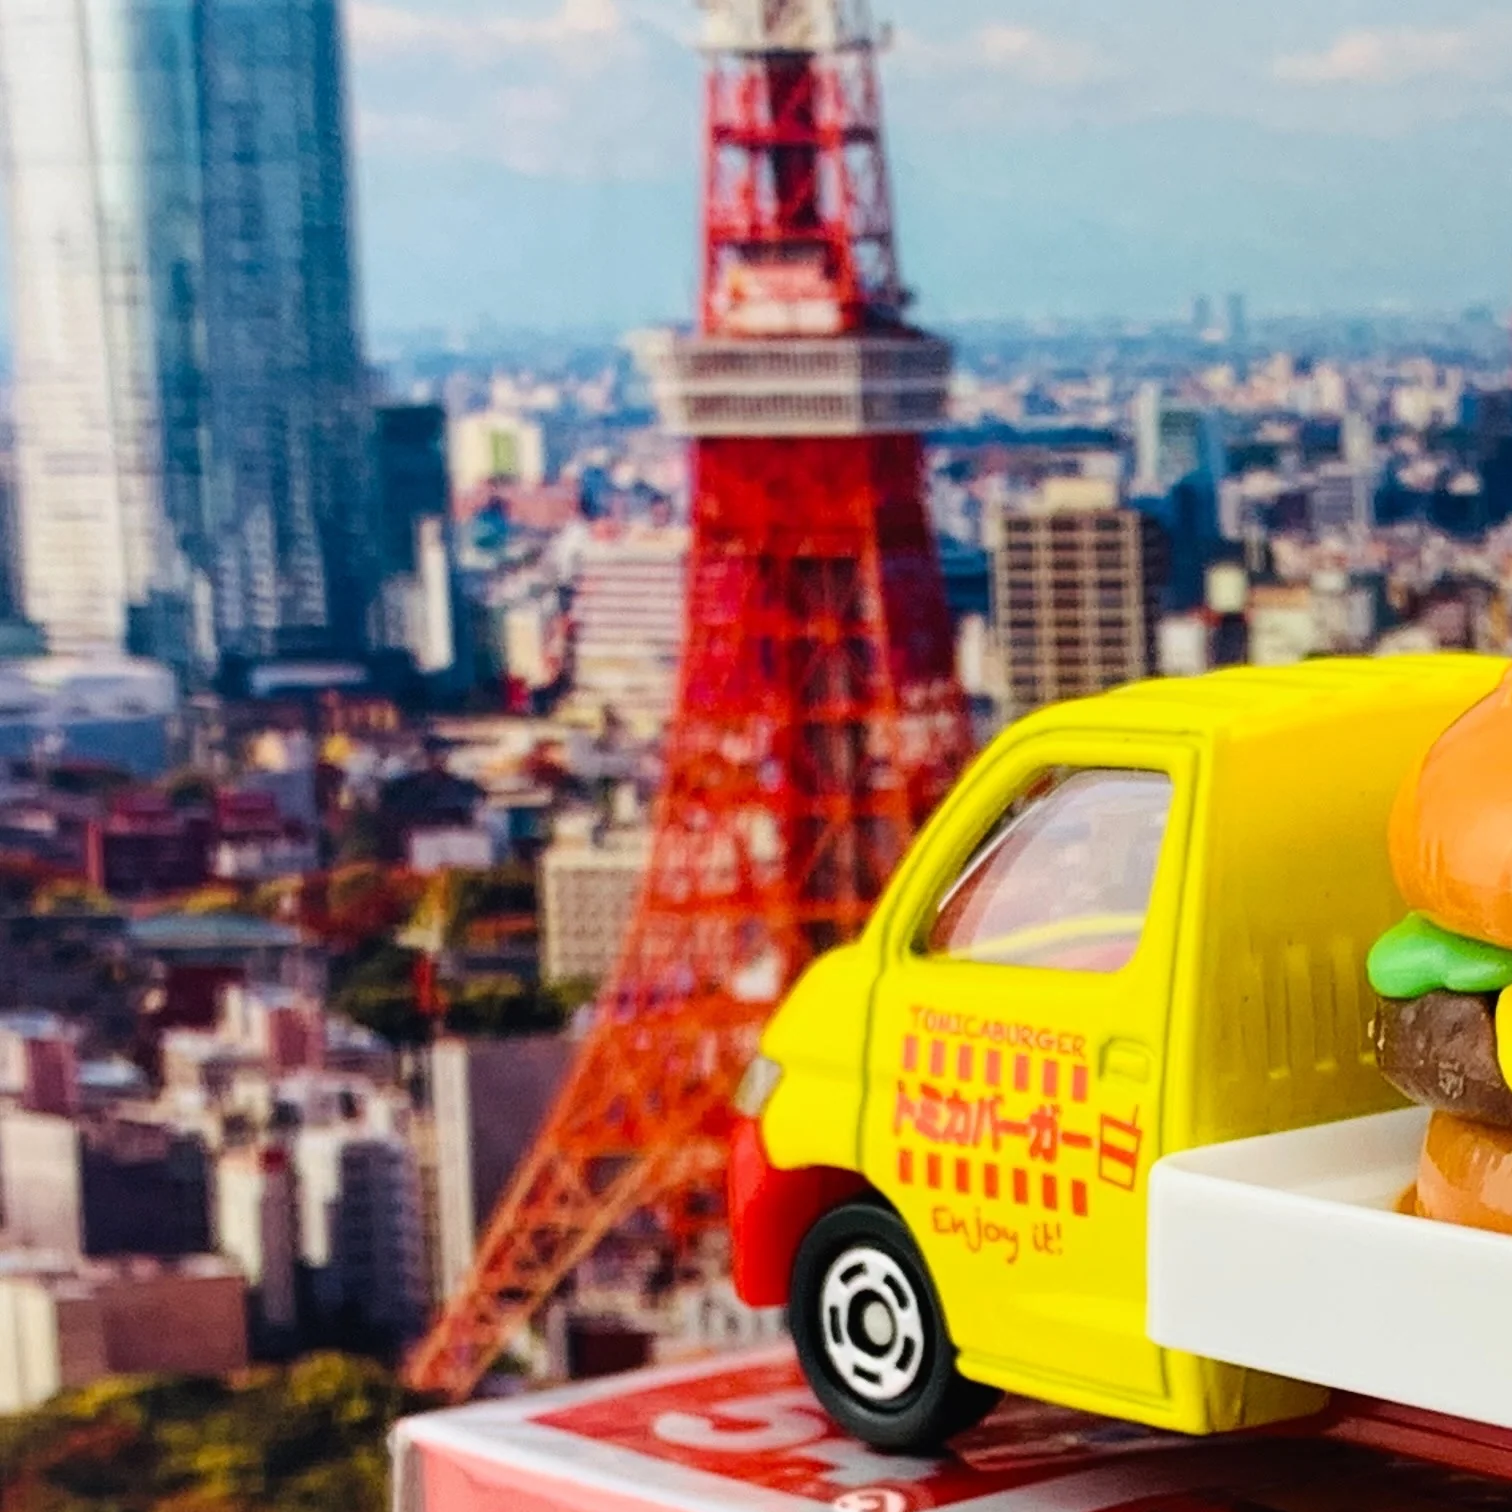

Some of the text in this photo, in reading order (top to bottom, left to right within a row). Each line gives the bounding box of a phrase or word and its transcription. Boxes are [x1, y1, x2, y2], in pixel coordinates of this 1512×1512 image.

[909, 1004, 1087, 1059] TOMICABURGER
[932, 1205, 1063, 1265] Enjoy it!
